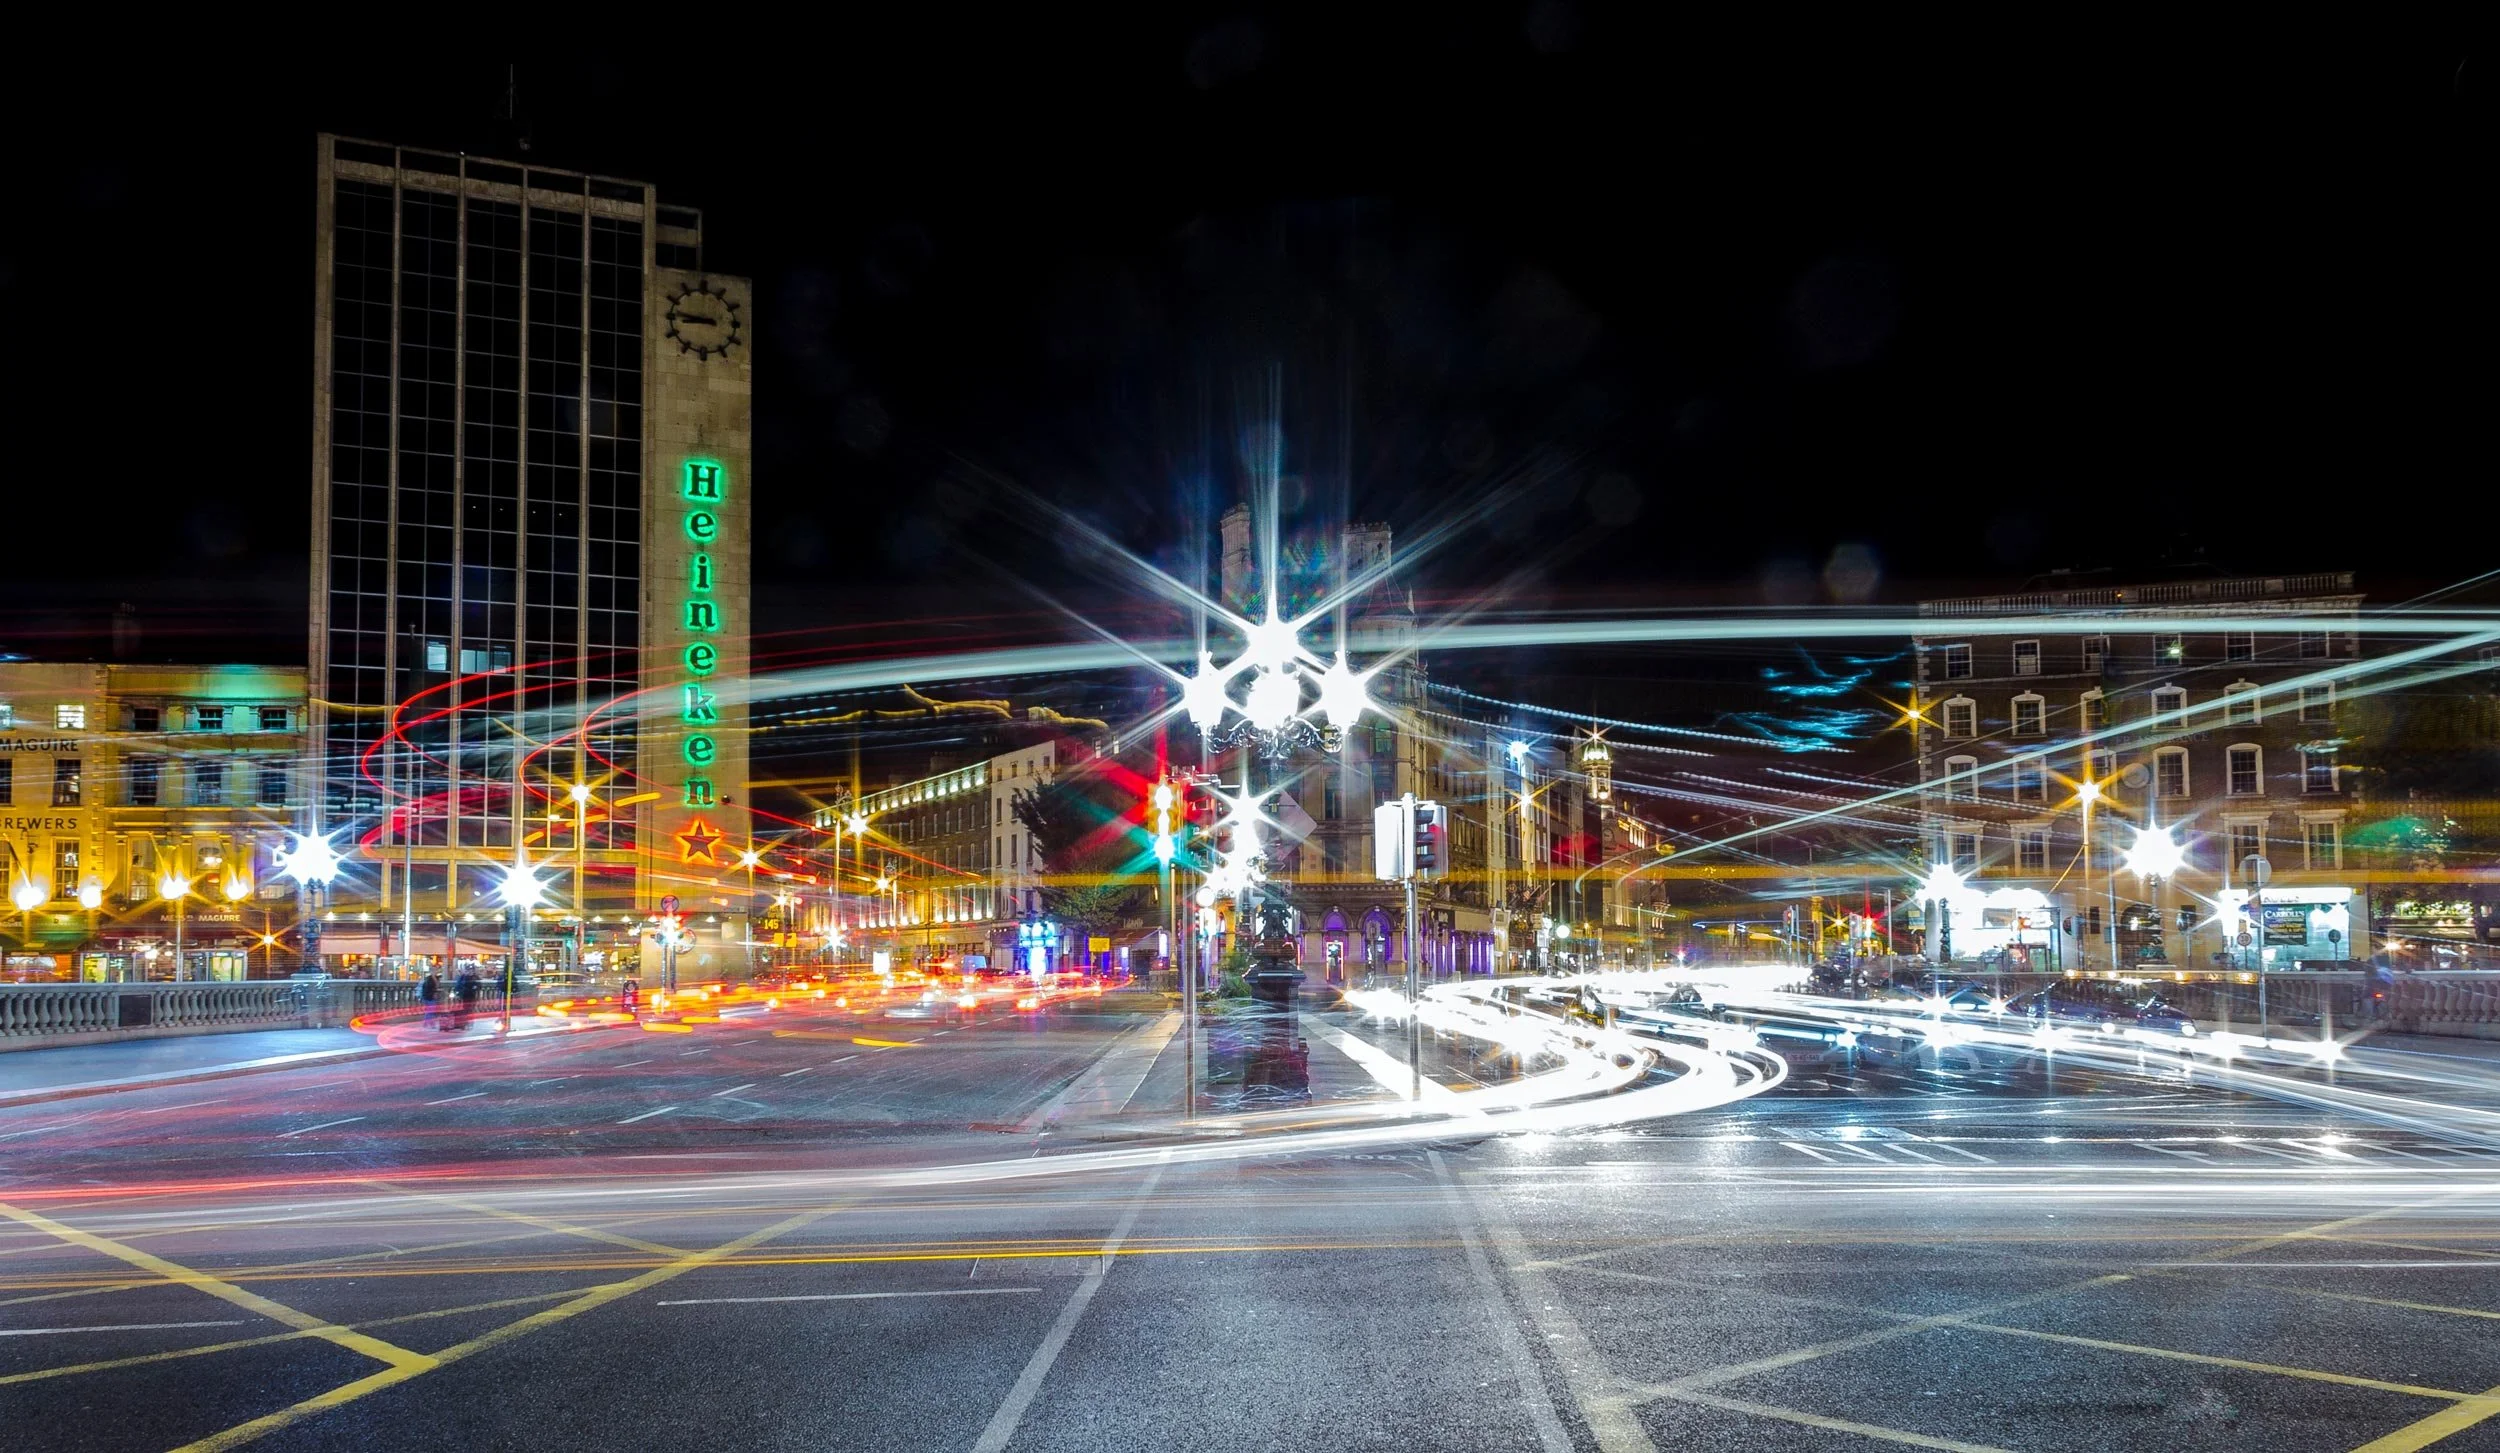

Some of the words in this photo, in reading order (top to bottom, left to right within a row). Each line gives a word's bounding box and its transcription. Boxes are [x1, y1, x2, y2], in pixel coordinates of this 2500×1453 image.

[686, 461, 721, 808] Heineken
[0, 738, 79, 752] MAGUIRE
[0, 817, 78, 830] REWERS
[198, 914, 241, 922] MAGUIRE
[764, 919, 779, 930] 145
[1779, 1142, 1998, 1164] NO
